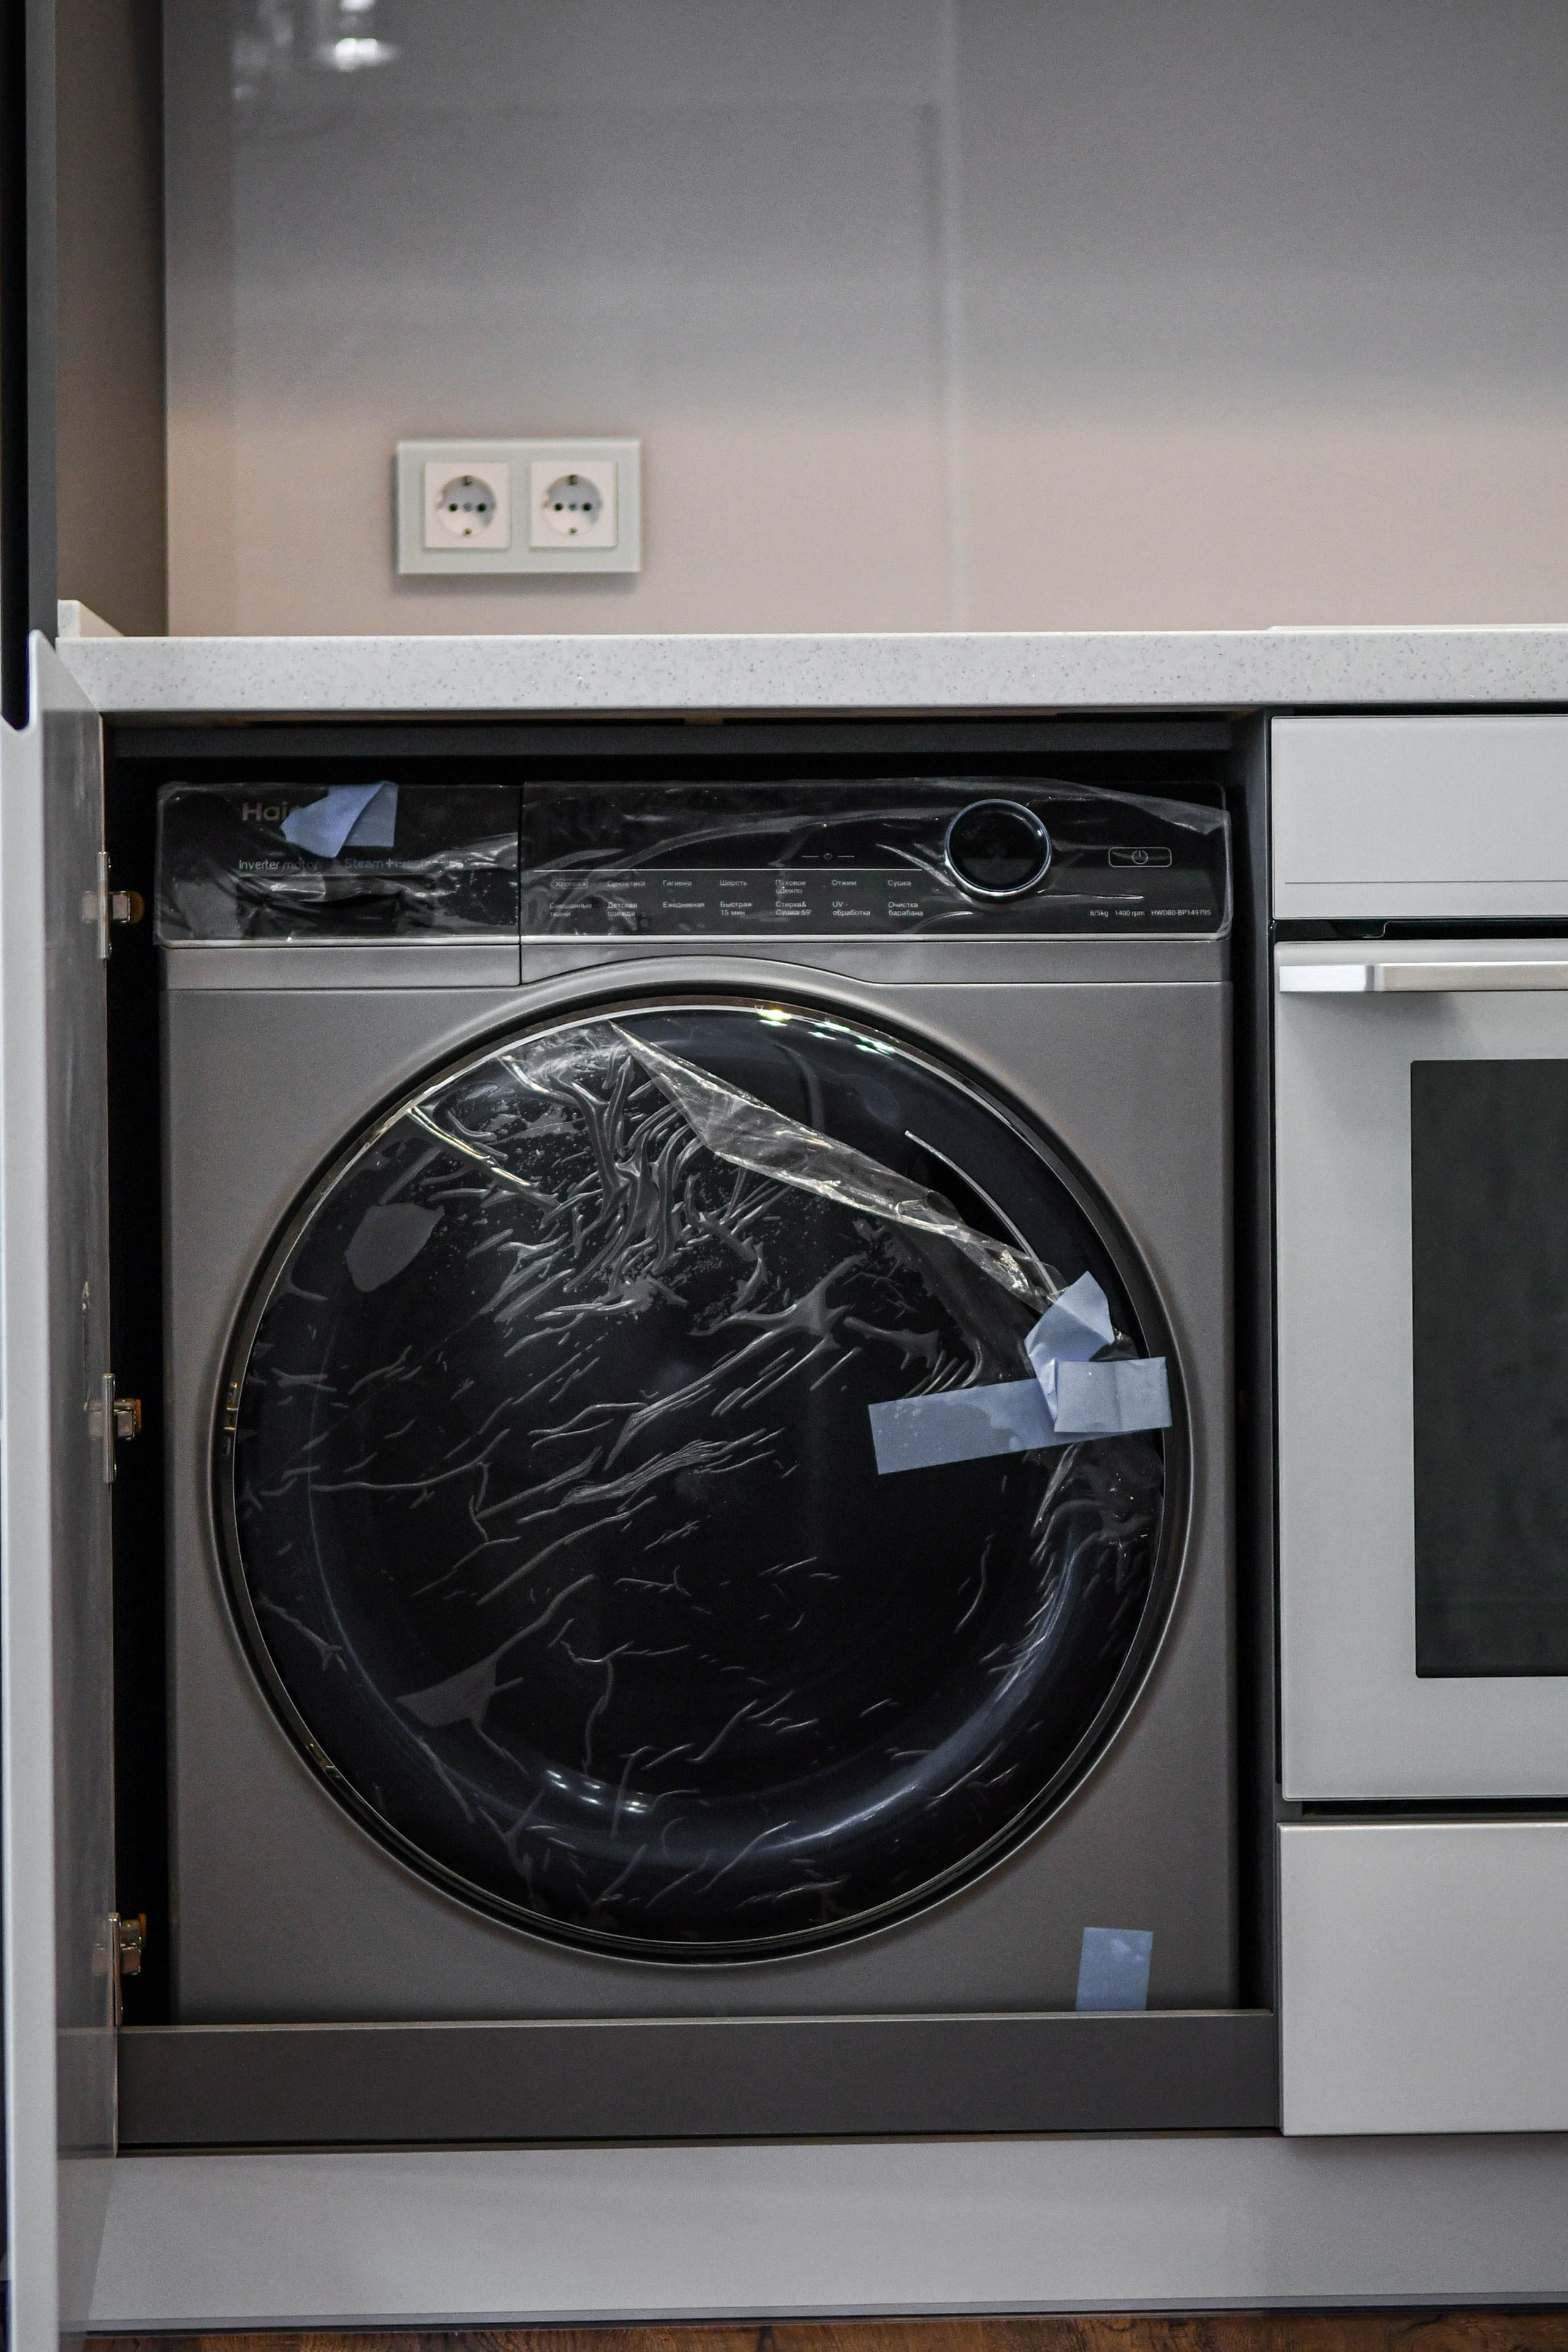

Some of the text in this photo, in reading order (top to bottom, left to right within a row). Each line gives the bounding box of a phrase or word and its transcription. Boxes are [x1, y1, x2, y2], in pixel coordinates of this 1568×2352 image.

[242, 801, 299, 821] Hai
[239, 858, 318, 870] Inverter motor
[720, 900, 752, 909] Быстрая
